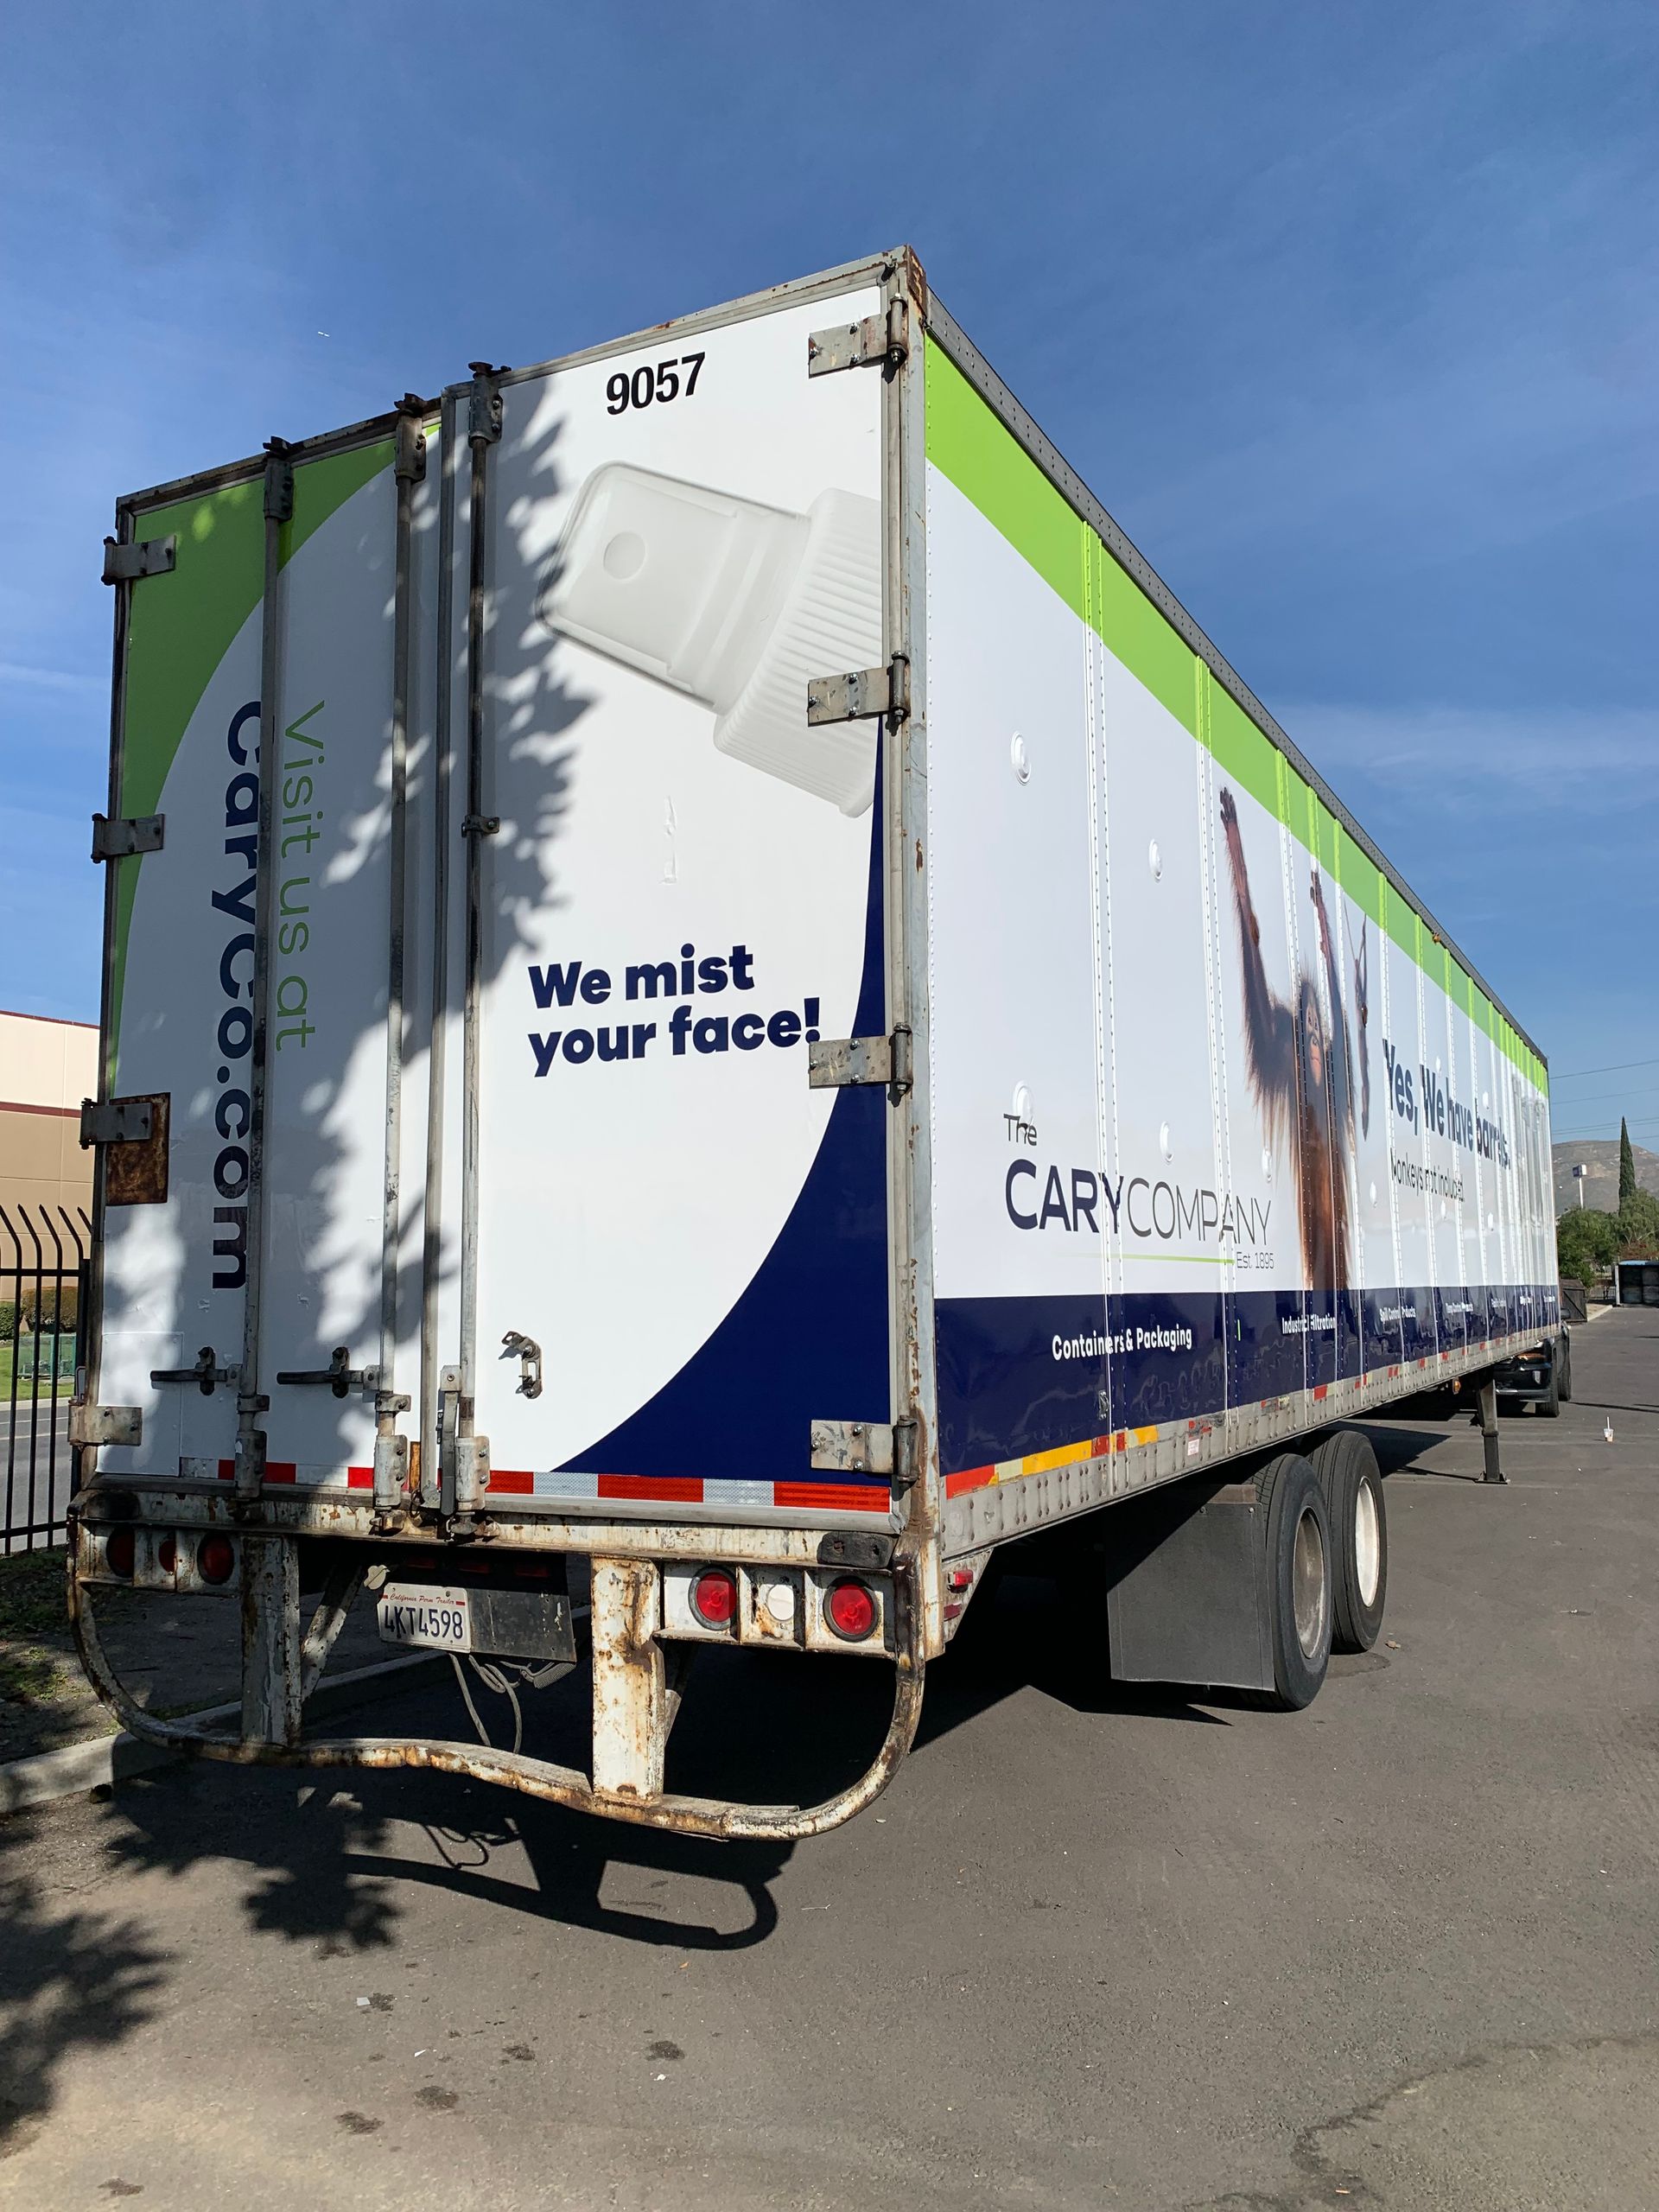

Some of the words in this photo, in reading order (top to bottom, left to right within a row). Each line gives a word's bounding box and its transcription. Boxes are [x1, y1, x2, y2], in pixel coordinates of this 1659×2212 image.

[606, 351, 705, 415] 9057
[281, 700, 325, 859] Visit
[278, 877, 310, 955] us
[527, 961, 612, 1009] We
[625, 943, 755, 1001] mist
[276, 976, 315, 1052] at
[527, 1022, 657, 1077] your
[668, 996, 821, 1056] face!
[1382, 1039, 1418, 1136] Yes,
[1420, 1064, 1445, 1136] We
[1446, 1077, 1473, 1152] have
[1003, 1113, 1038, 1146] The
[1255, 1252, 1274, 1269] 1895
[1052, 1330, 1124, 1361] Containers
[1126, 1328, 1133, 1351] &
[1136, 1324, 1192, 1351] Packaging
[385, 1605, 463, 1639] 4KT4598
[390, 1593, 416, 1603] California
[435, 1596, 454, 1605] Trailer
